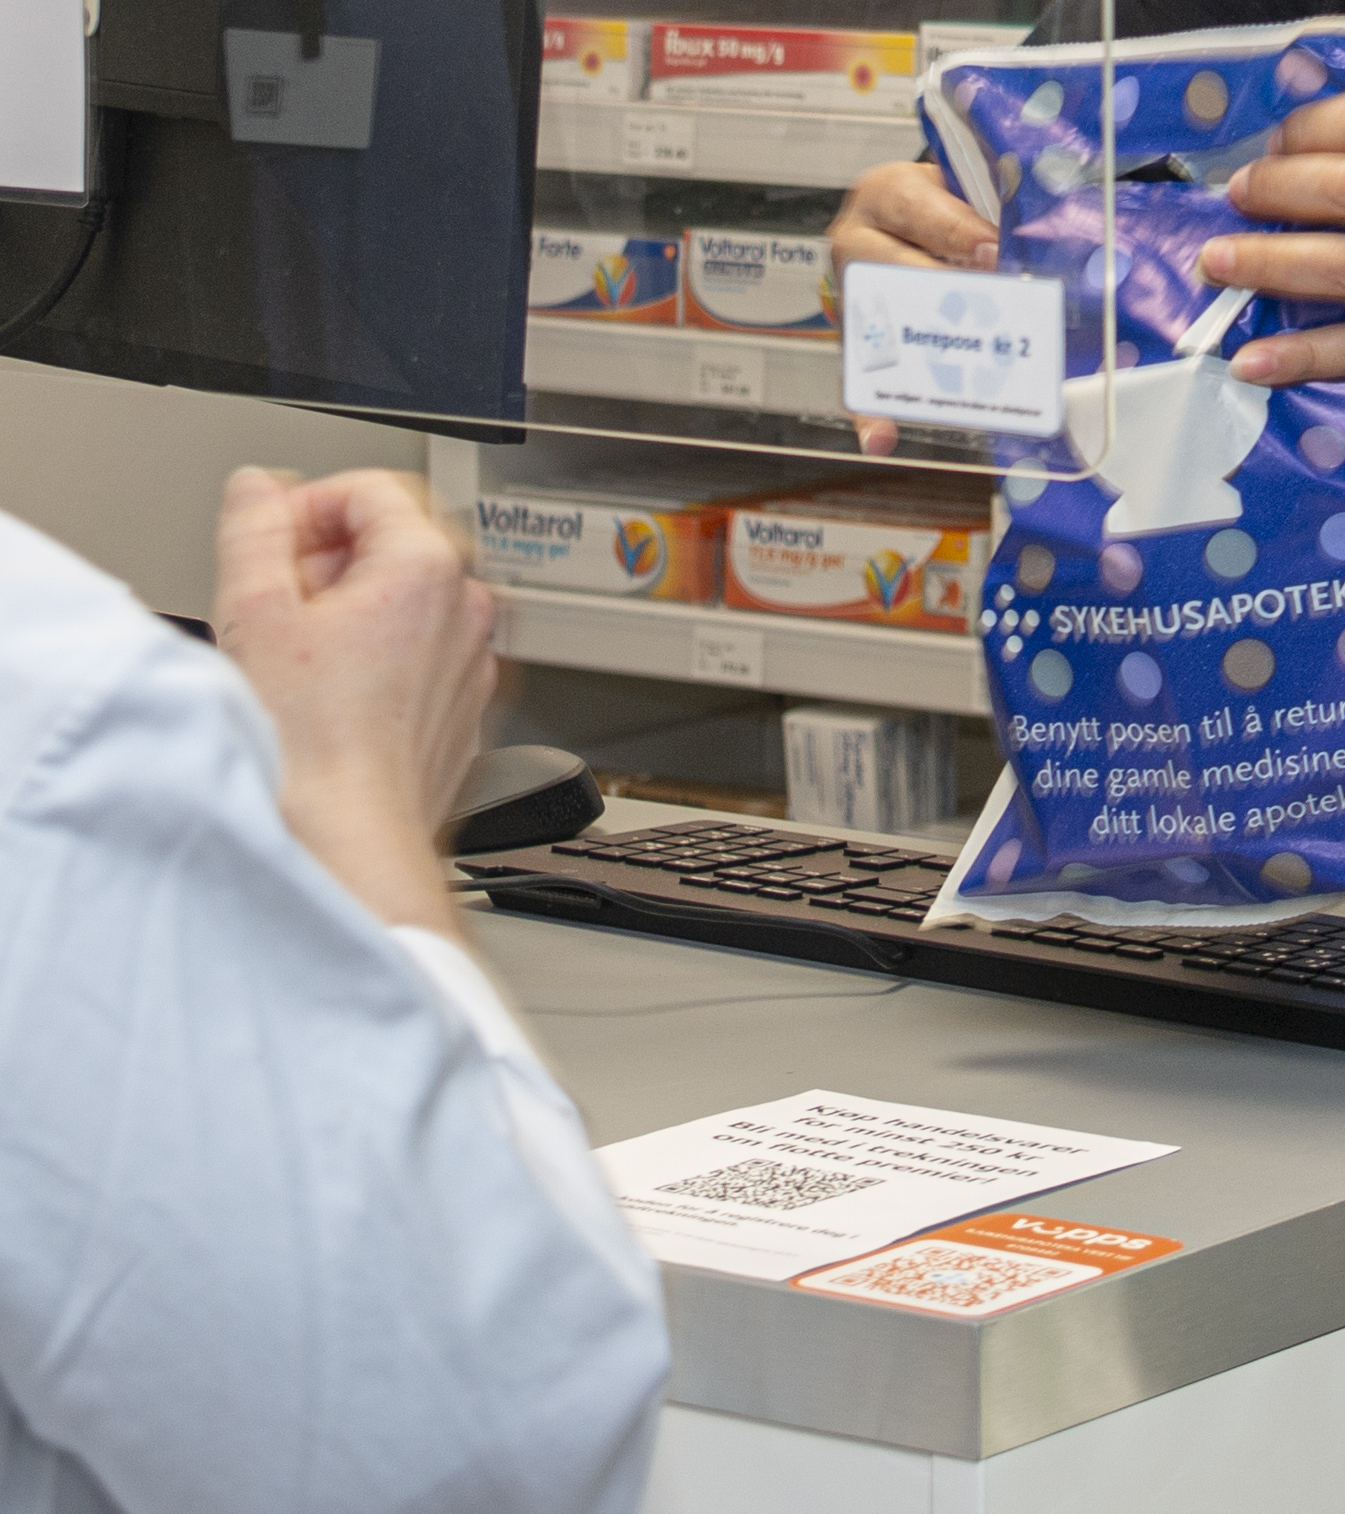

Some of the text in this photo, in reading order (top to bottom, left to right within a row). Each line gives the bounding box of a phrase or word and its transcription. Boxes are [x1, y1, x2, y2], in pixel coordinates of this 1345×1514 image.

[664, 30, 715, 58] Ibux
[537, 236, 584, 260] Forte
[699, 236, 819, 264] Voltarol Forte
[901, 326, 983, 354] Berepose
[1015, 337, 1030, 357] 2
[477, 500, 584, 540] Voltarol
[745, 517, 825, 549] Voltarol
[1009, 712, 1103, 749] Benytt
[1109, 716, 1193, 754] posen
[1201, 708, 1234, 740] til
[1243, 704, 1264, 736] å
[1033, 760, 1100, 795] dine
[1107, 759, 1193, 800] gamle
[1089, 804, 1142, 841] ditt
[1147, 798, 1238, 837] lokale
[725, 1120, 771, 1135] Bli
[774, 1129, 840, 1148] med
[867, 1144, 1041, 1178] trekningen
[791, 1115, 1045, 1164] for minst 250 kr
[805, 1103, 1092, 1157] Kjøp handelsvarer
[710, 1133, 1001, 1186] om flotte premier!
